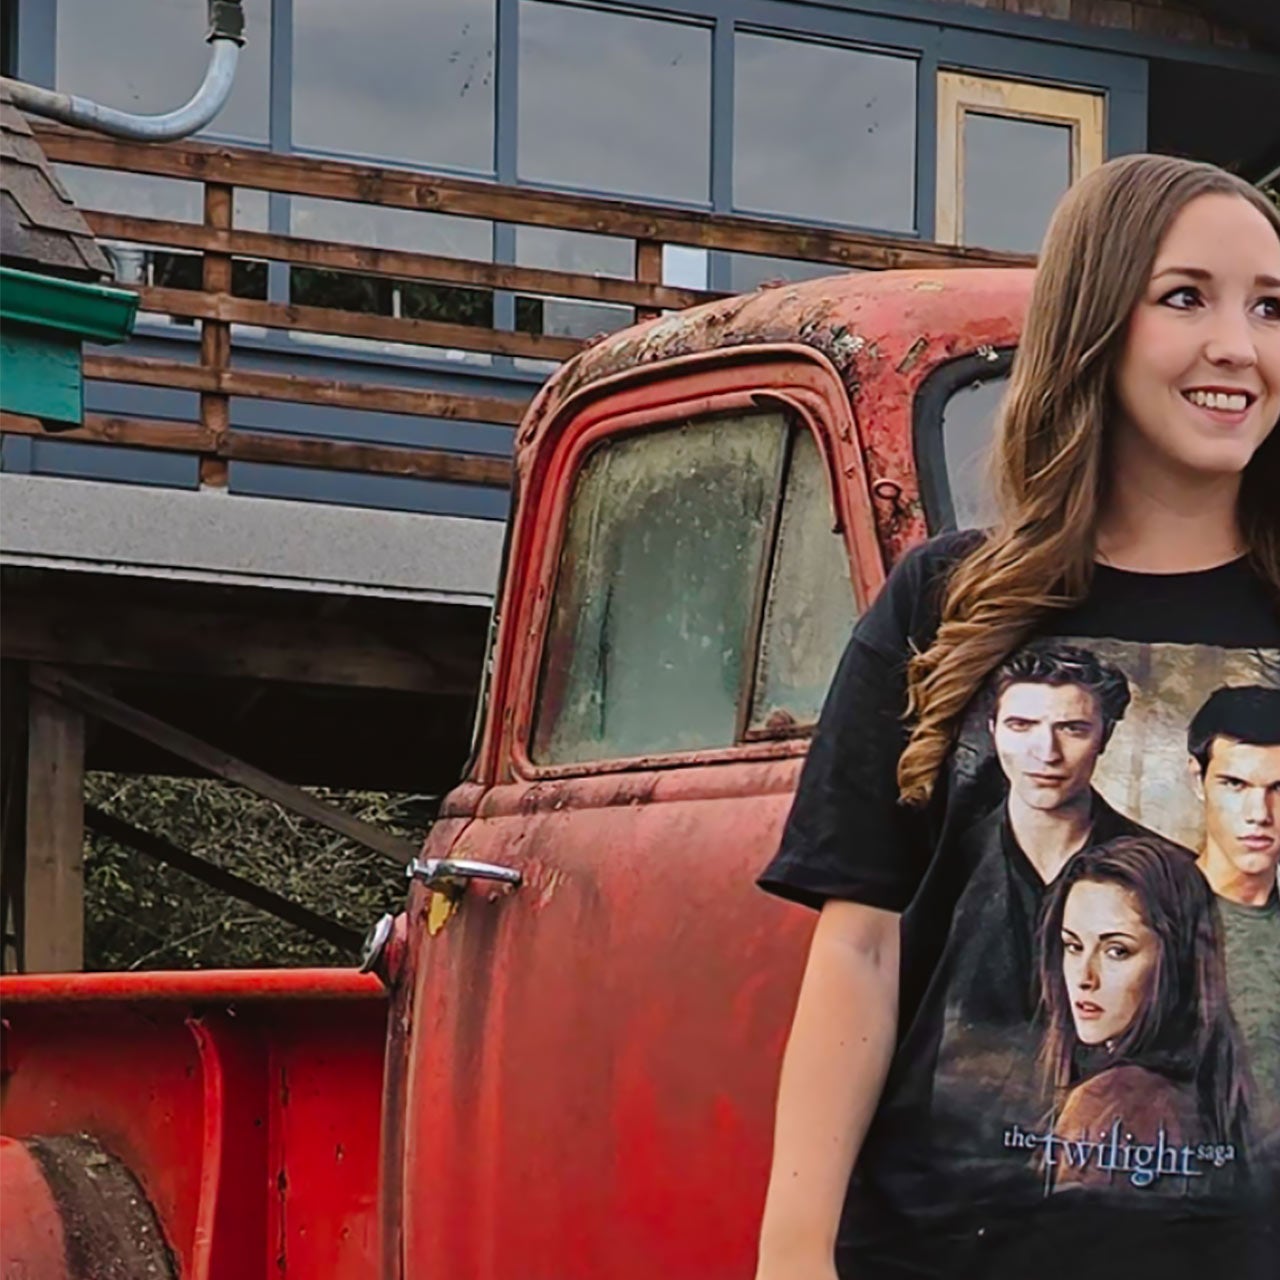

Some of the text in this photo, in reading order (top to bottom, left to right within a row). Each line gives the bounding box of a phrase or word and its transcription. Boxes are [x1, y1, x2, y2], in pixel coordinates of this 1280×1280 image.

[1003, 1114, 1235, 1190] the twilight saga
